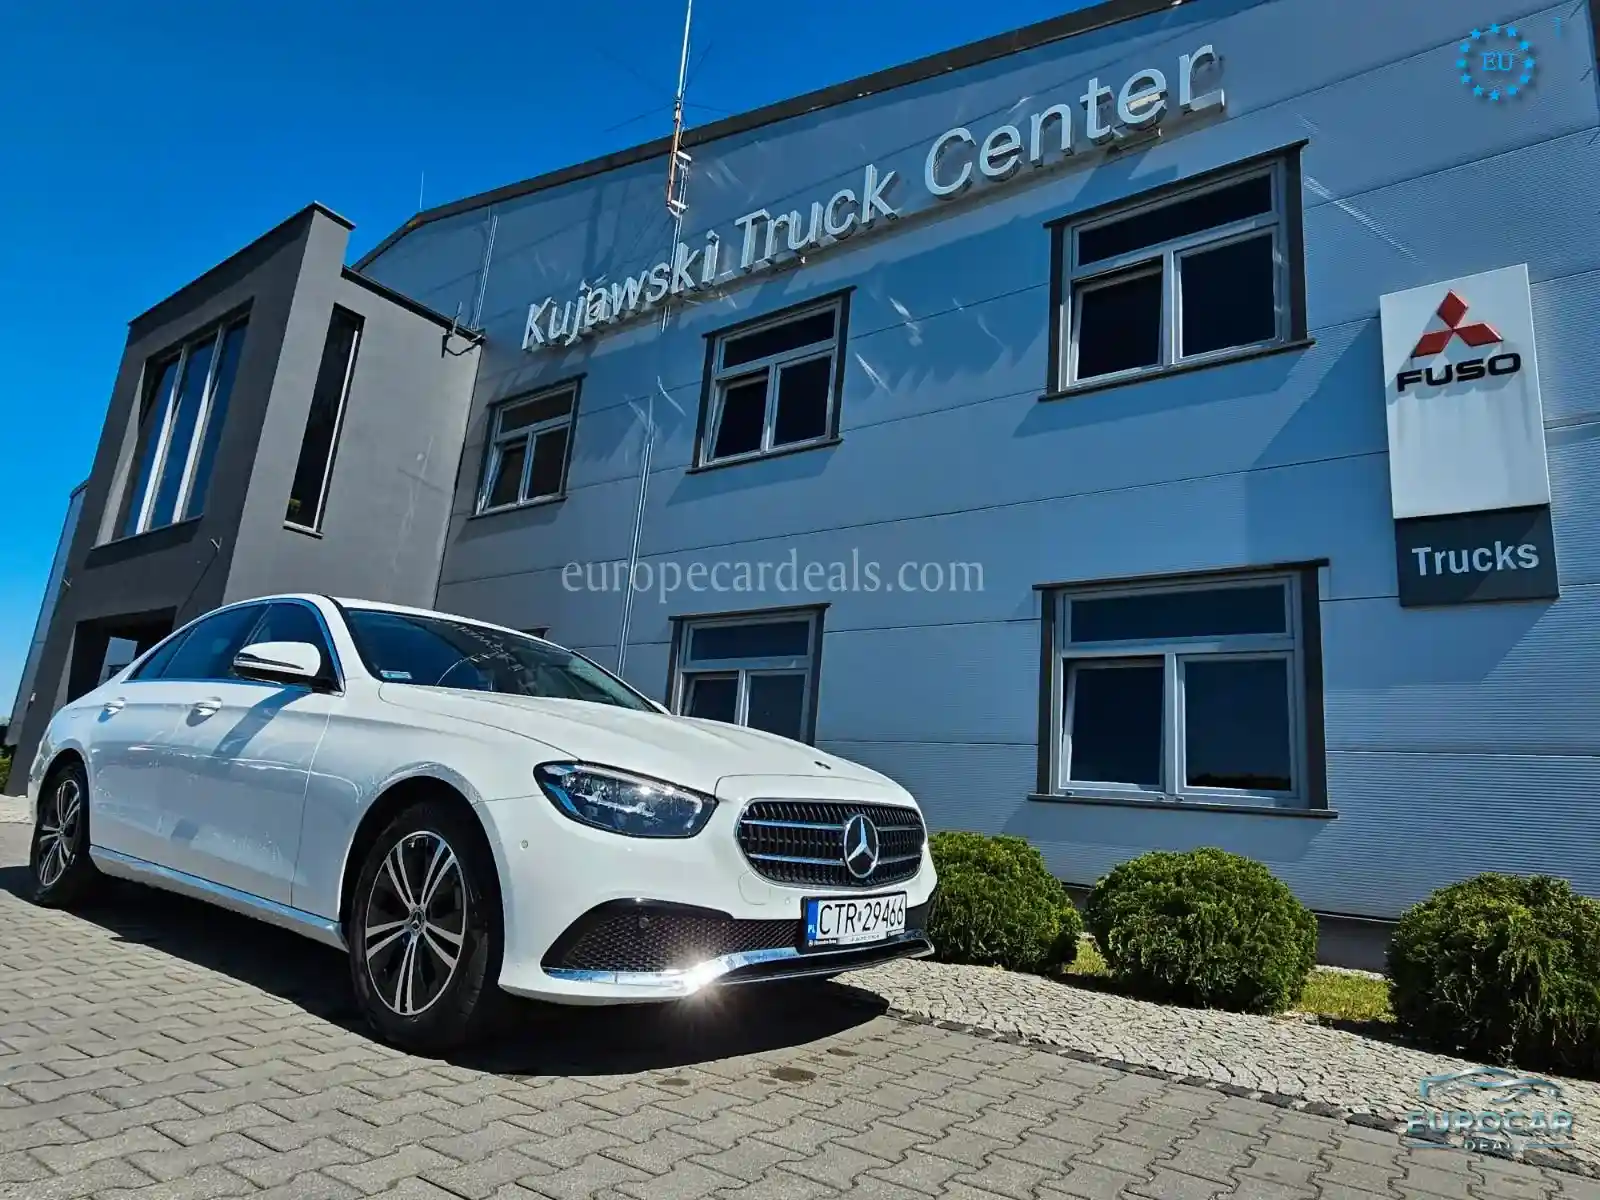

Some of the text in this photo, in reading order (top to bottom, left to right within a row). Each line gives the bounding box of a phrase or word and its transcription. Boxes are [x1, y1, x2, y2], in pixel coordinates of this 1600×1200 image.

[521, 44, 1225, 351] Kujawski Truck Center
[1396, 352, 1522, 393] FUSO
[1411, 541, 1540, 577] Trucks
[819, 897, 905, 935] CTR 29466
